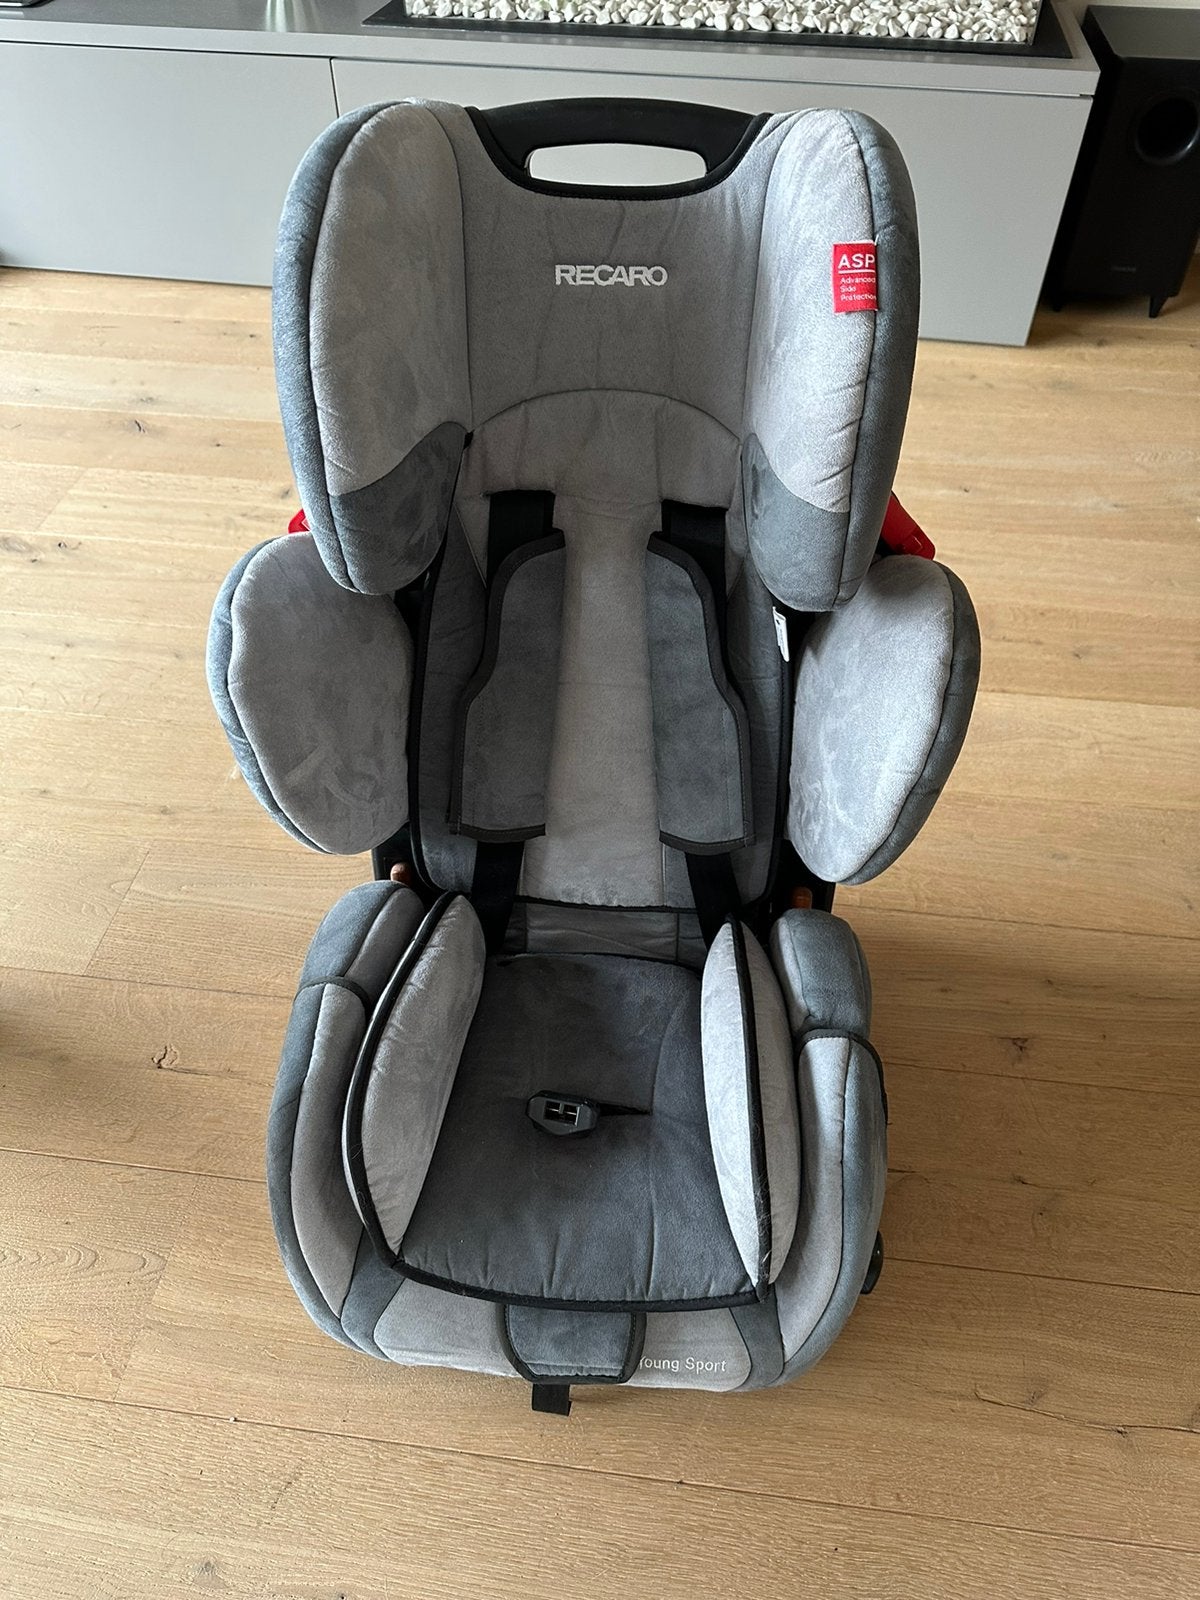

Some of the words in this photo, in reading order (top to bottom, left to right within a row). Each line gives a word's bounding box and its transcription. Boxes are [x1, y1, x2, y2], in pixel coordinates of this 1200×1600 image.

[838, 253, 875, 269] ASP
[555, 264, 668, 286] RECARO
[685, 1356, 727, 1375] Sport
